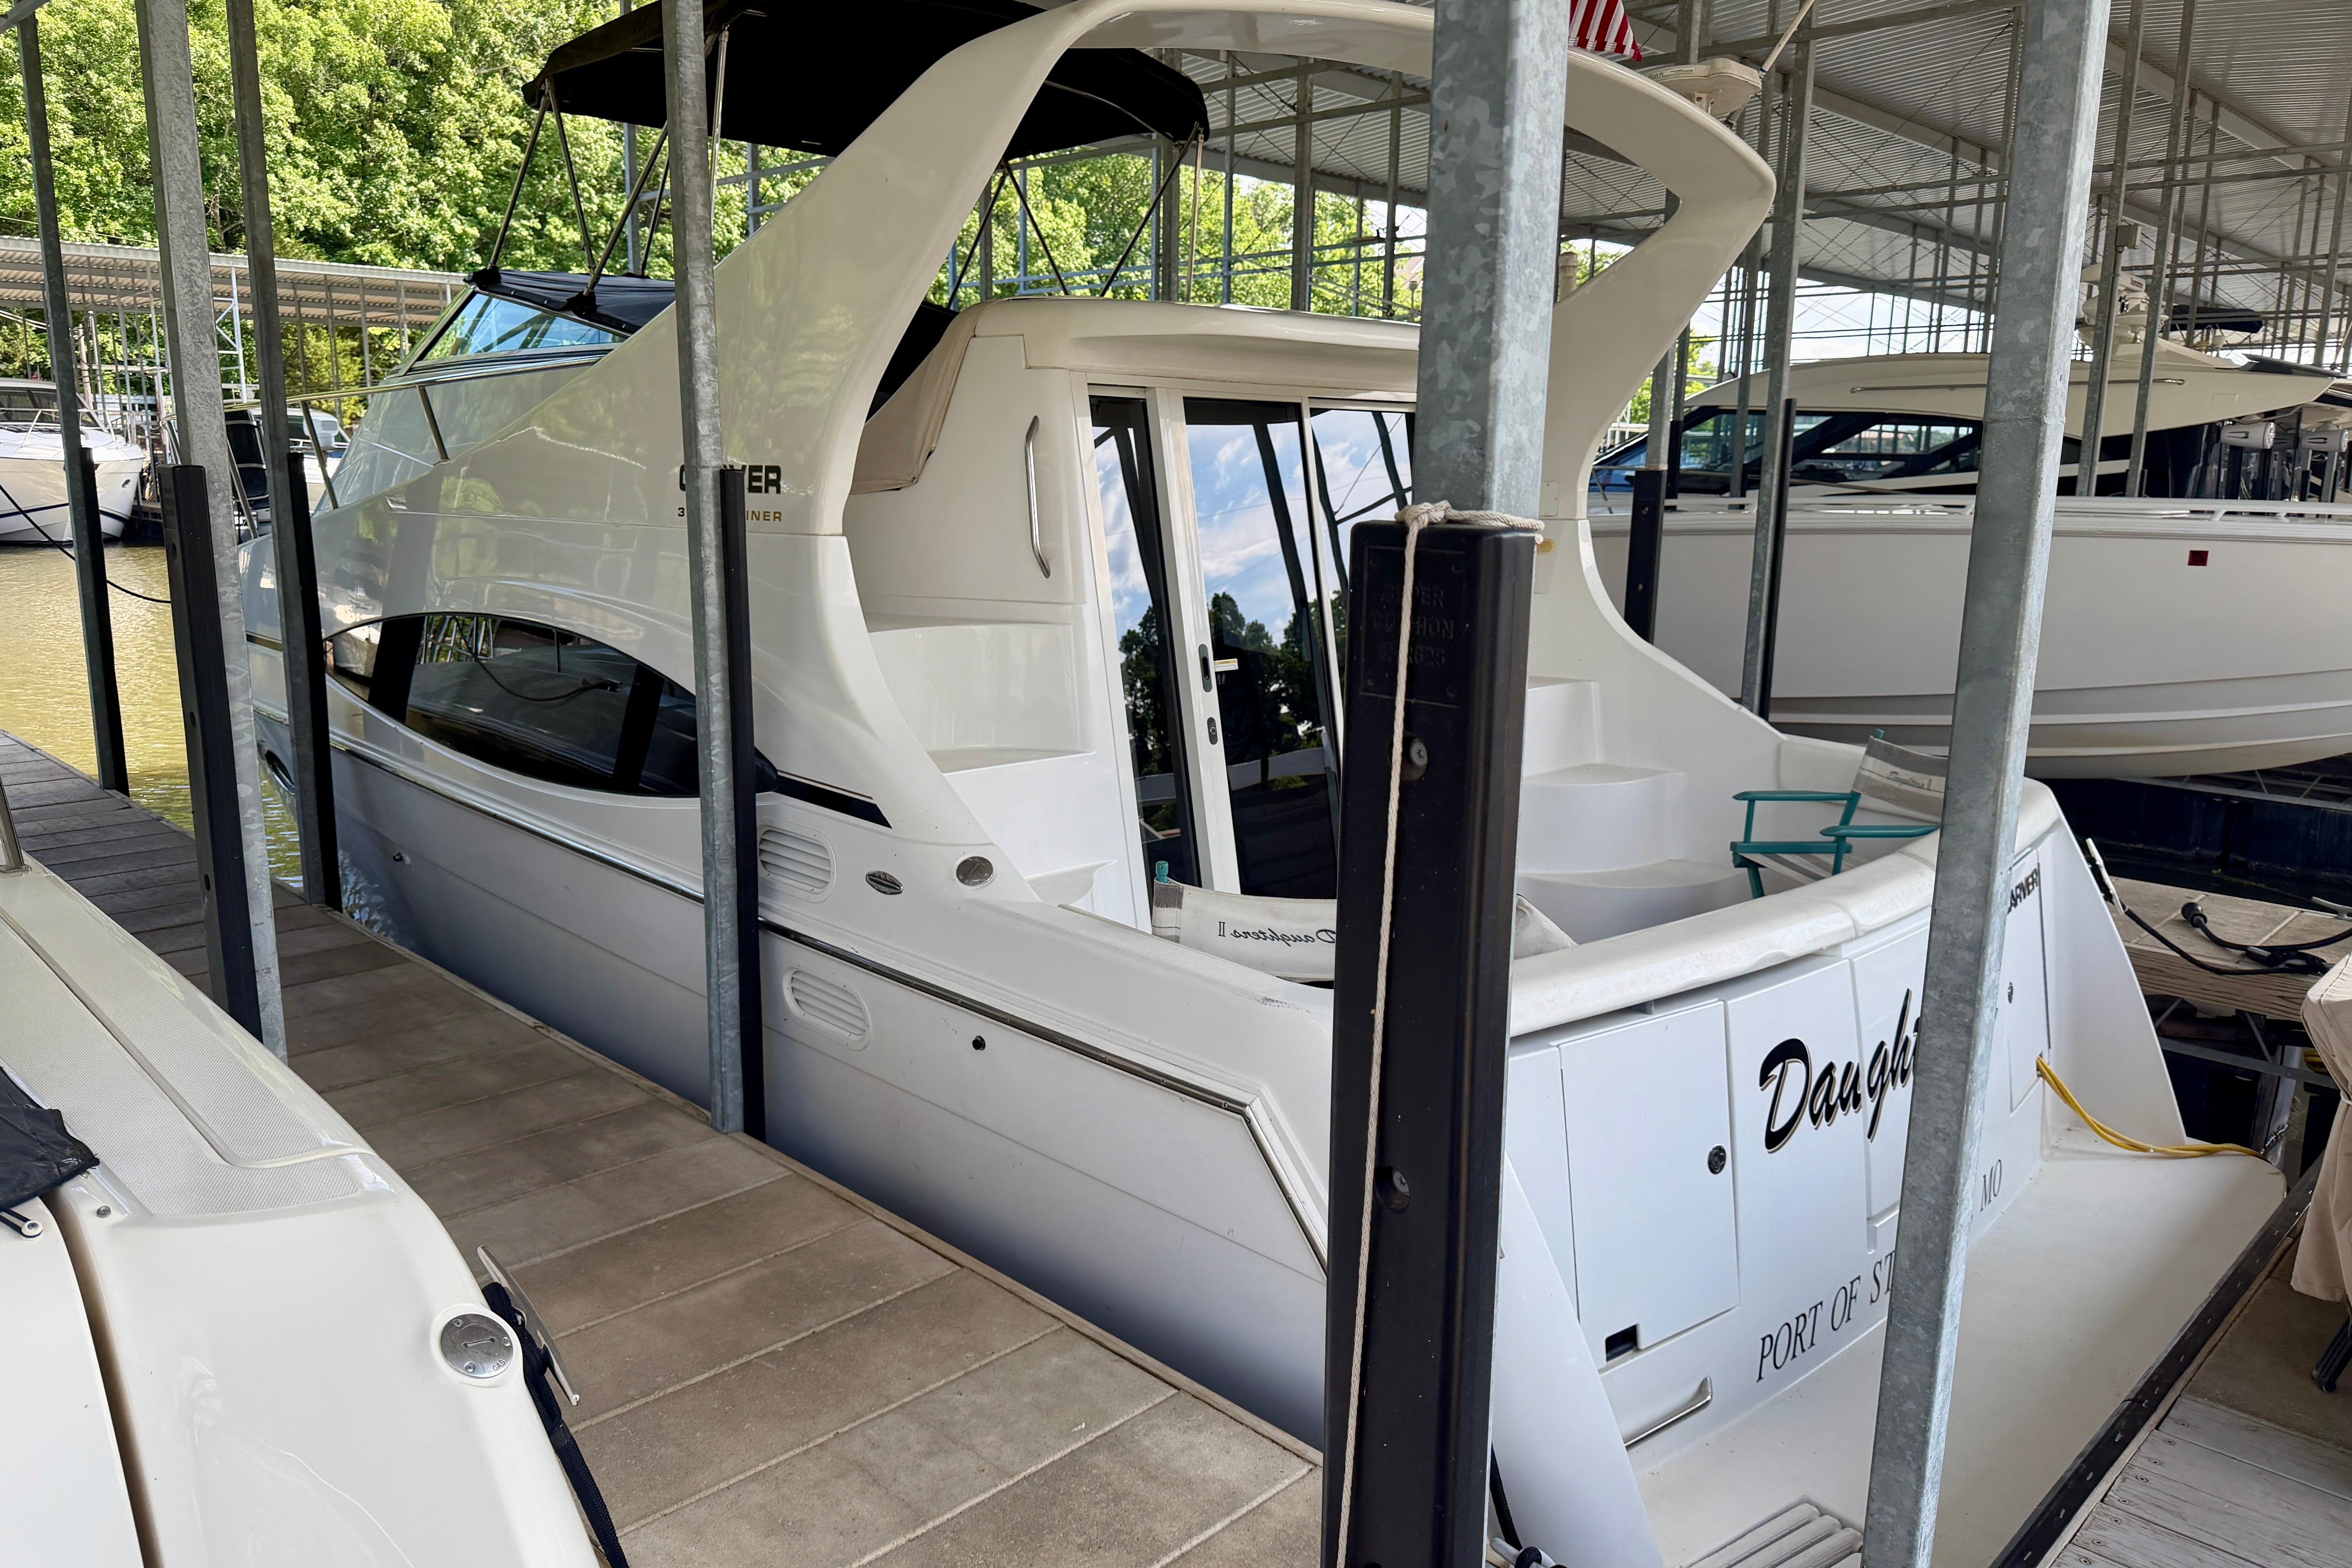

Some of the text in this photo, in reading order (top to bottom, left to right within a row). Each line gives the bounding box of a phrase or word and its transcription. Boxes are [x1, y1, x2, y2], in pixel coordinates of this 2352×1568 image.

[747, 510, 782, 522] INER
[2007, 868, 2038, 915] ARVER
[1759, 988, 1920, 1154] Daugh
[1756, 1301, 1823, 1383] PORT
[1831, 1275, 1861, 1331] OF
[1980, 1159, 2002, 1213] MO
[492, 1358, 505, 1371] GAS
